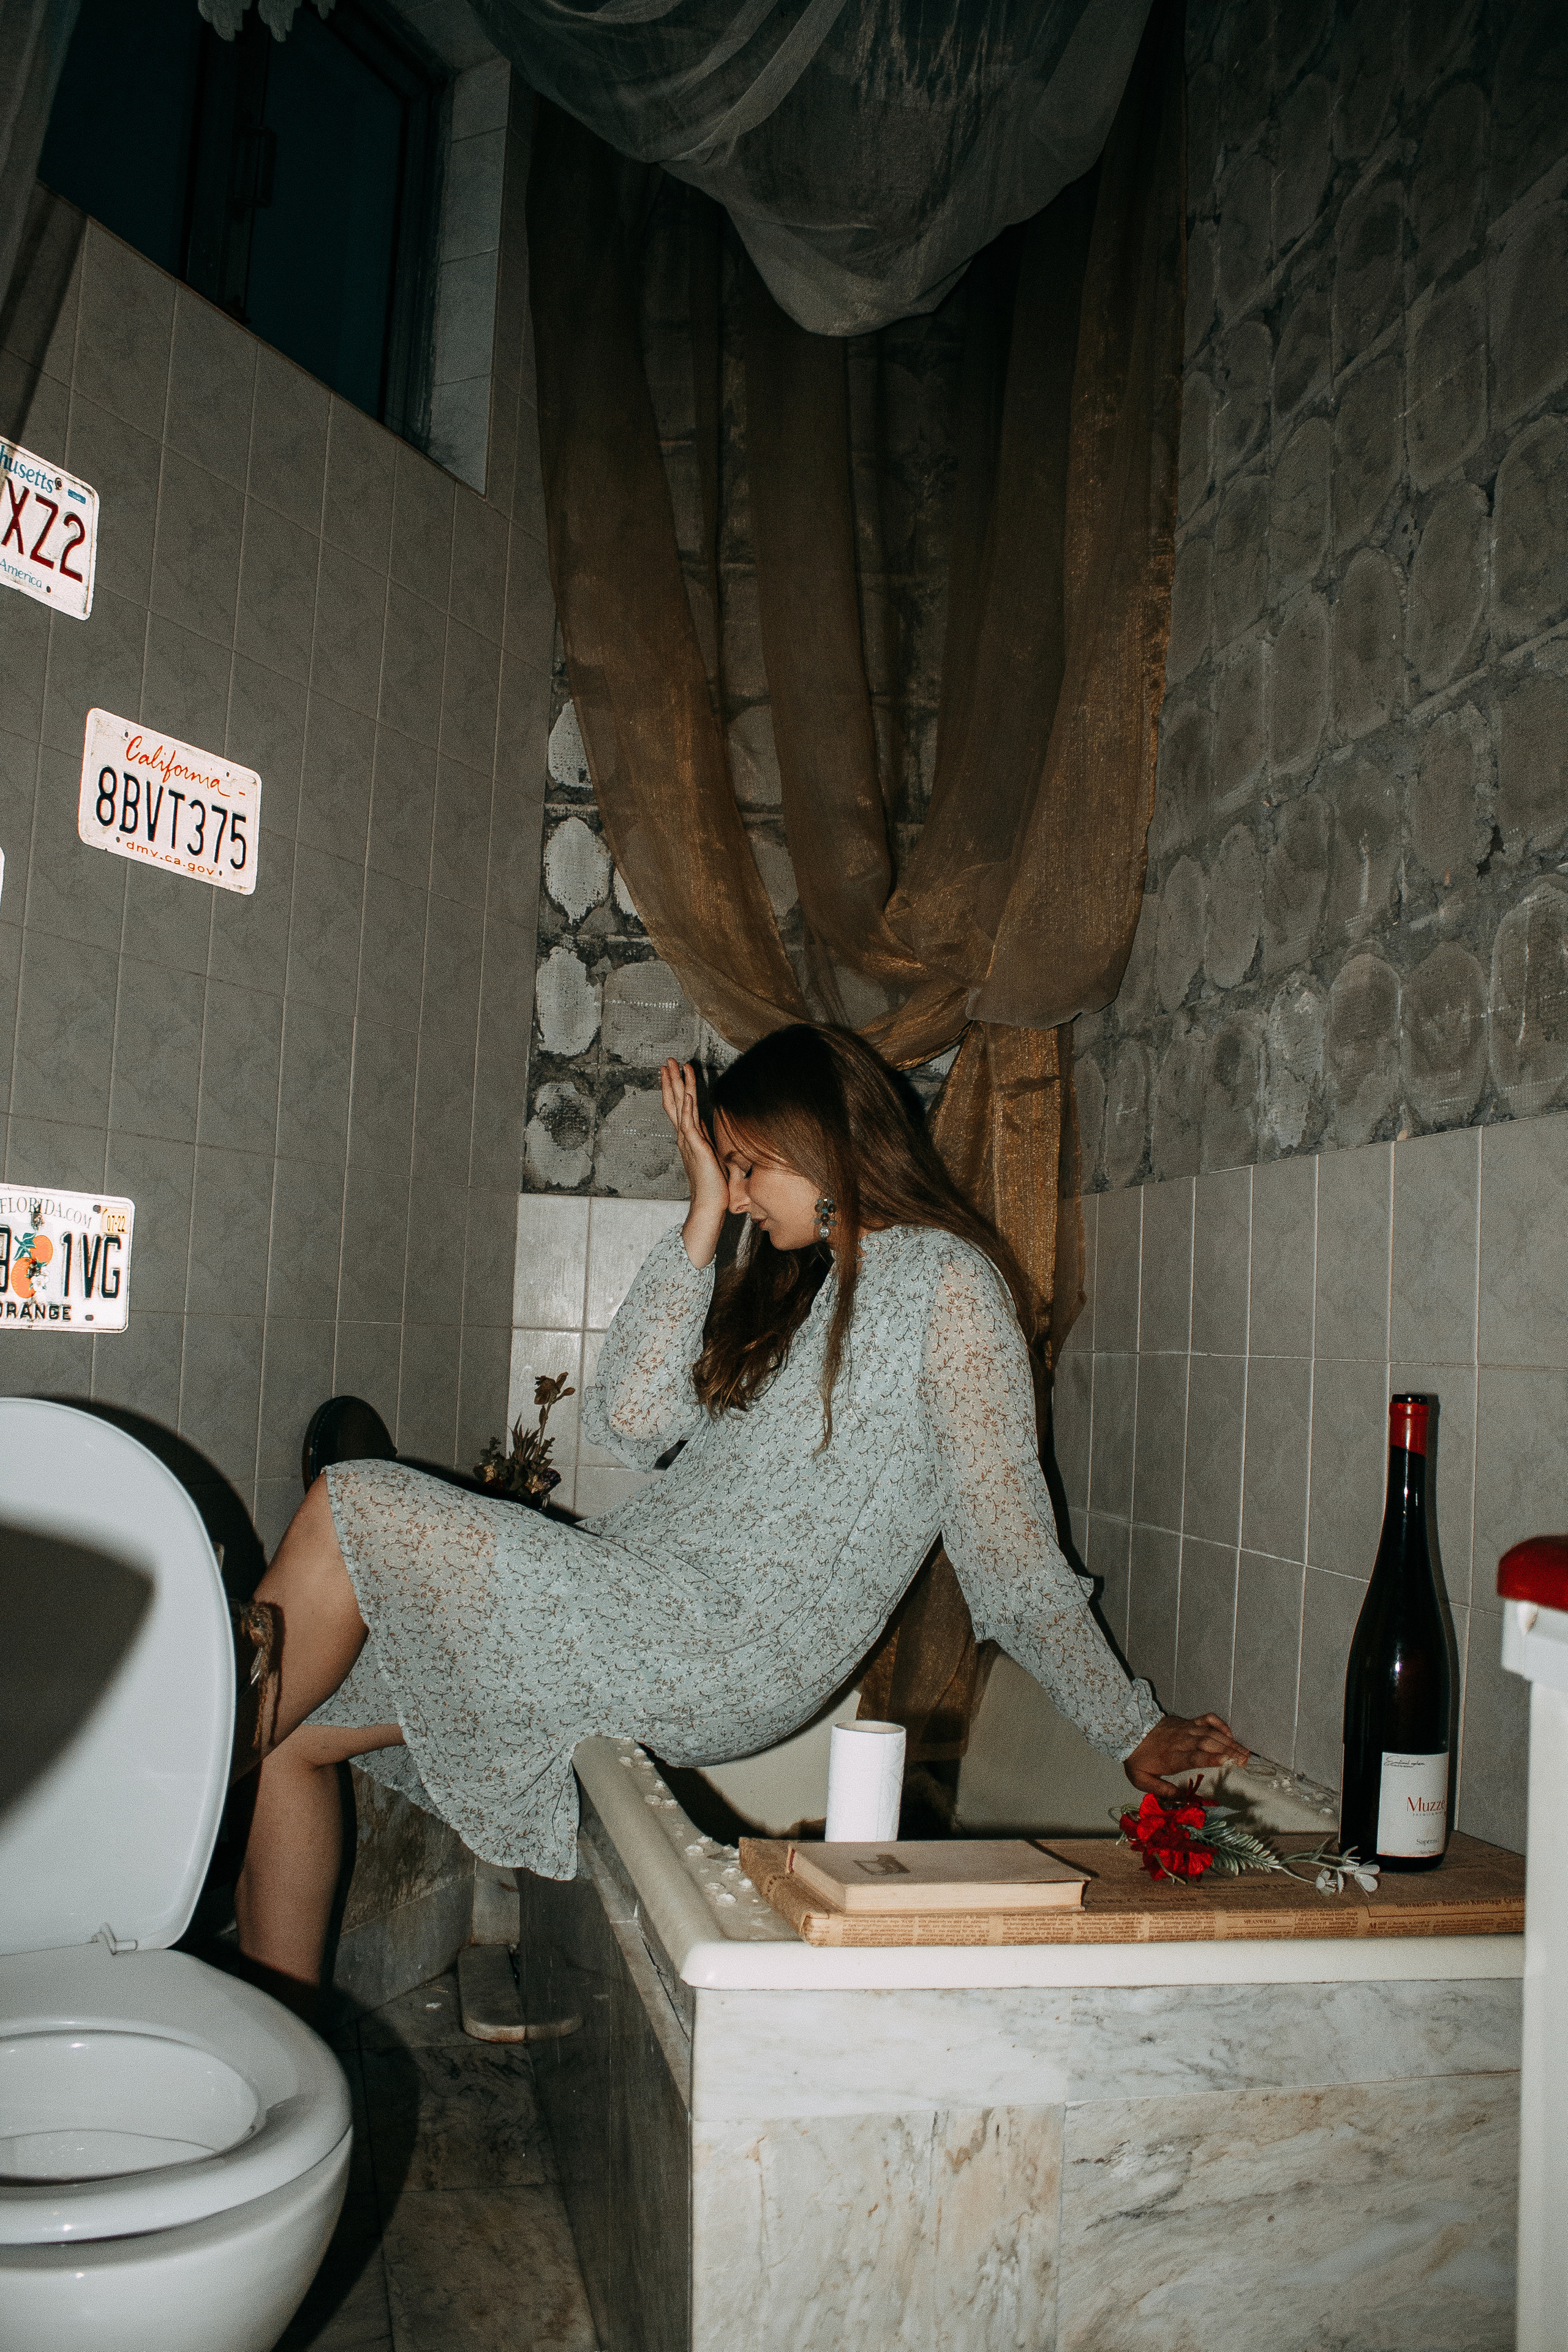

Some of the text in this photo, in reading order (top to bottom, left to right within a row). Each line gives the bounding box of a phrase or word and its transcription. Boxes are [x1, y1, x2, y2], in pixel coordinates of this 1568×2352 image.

[1, 477, 85, 583] XZ2
[126, 735, 230, 797] California
[96, 766, 246, 870] 8BVT375
[126, 841, 214, 875] dmv.ca.gov
[63, 1233, 121, 1298] 1VG
